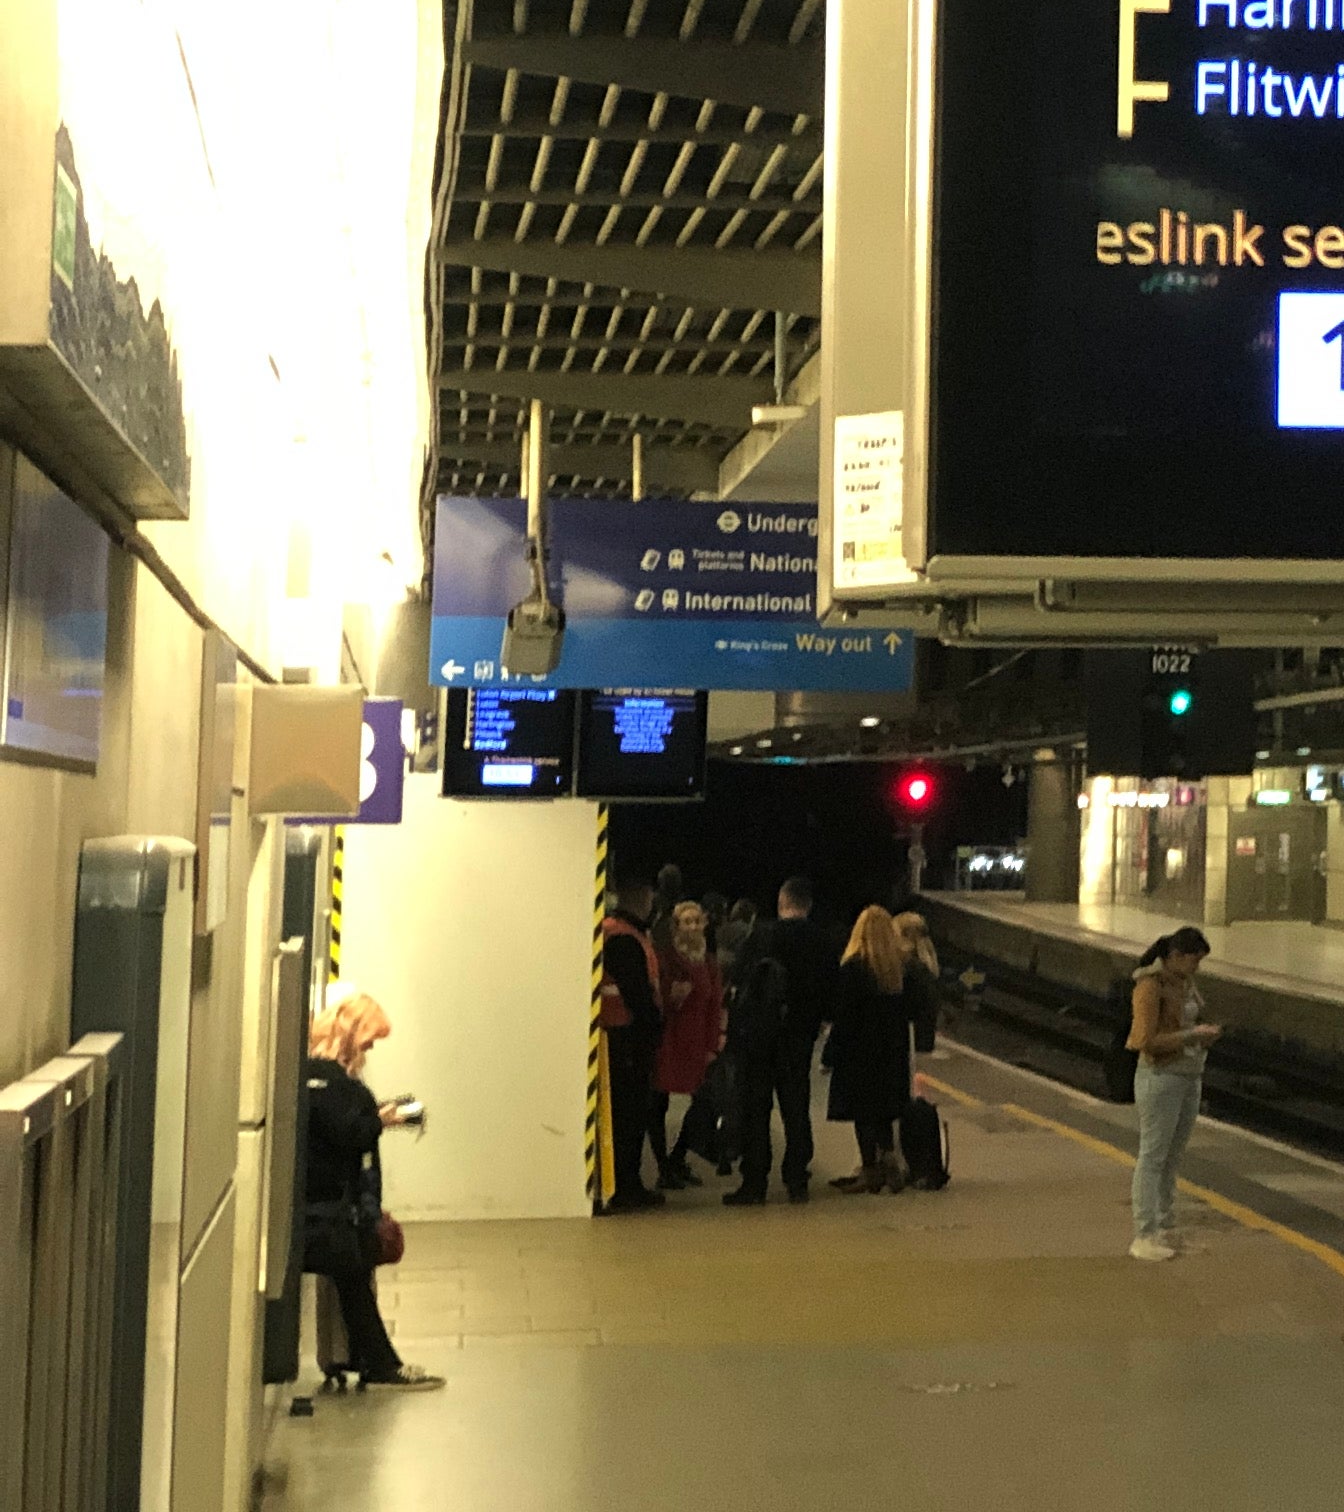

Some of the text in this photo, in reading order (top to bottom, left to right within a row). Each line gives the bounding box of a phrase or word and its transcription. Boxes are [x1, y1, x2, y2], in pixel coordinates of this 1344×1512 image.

[750, 552, 818, 573] Nation
[684, 591, 812, 613] International
[796, 633, 872, 655] Way out
[1152, 655, 1192, 674] 1022
